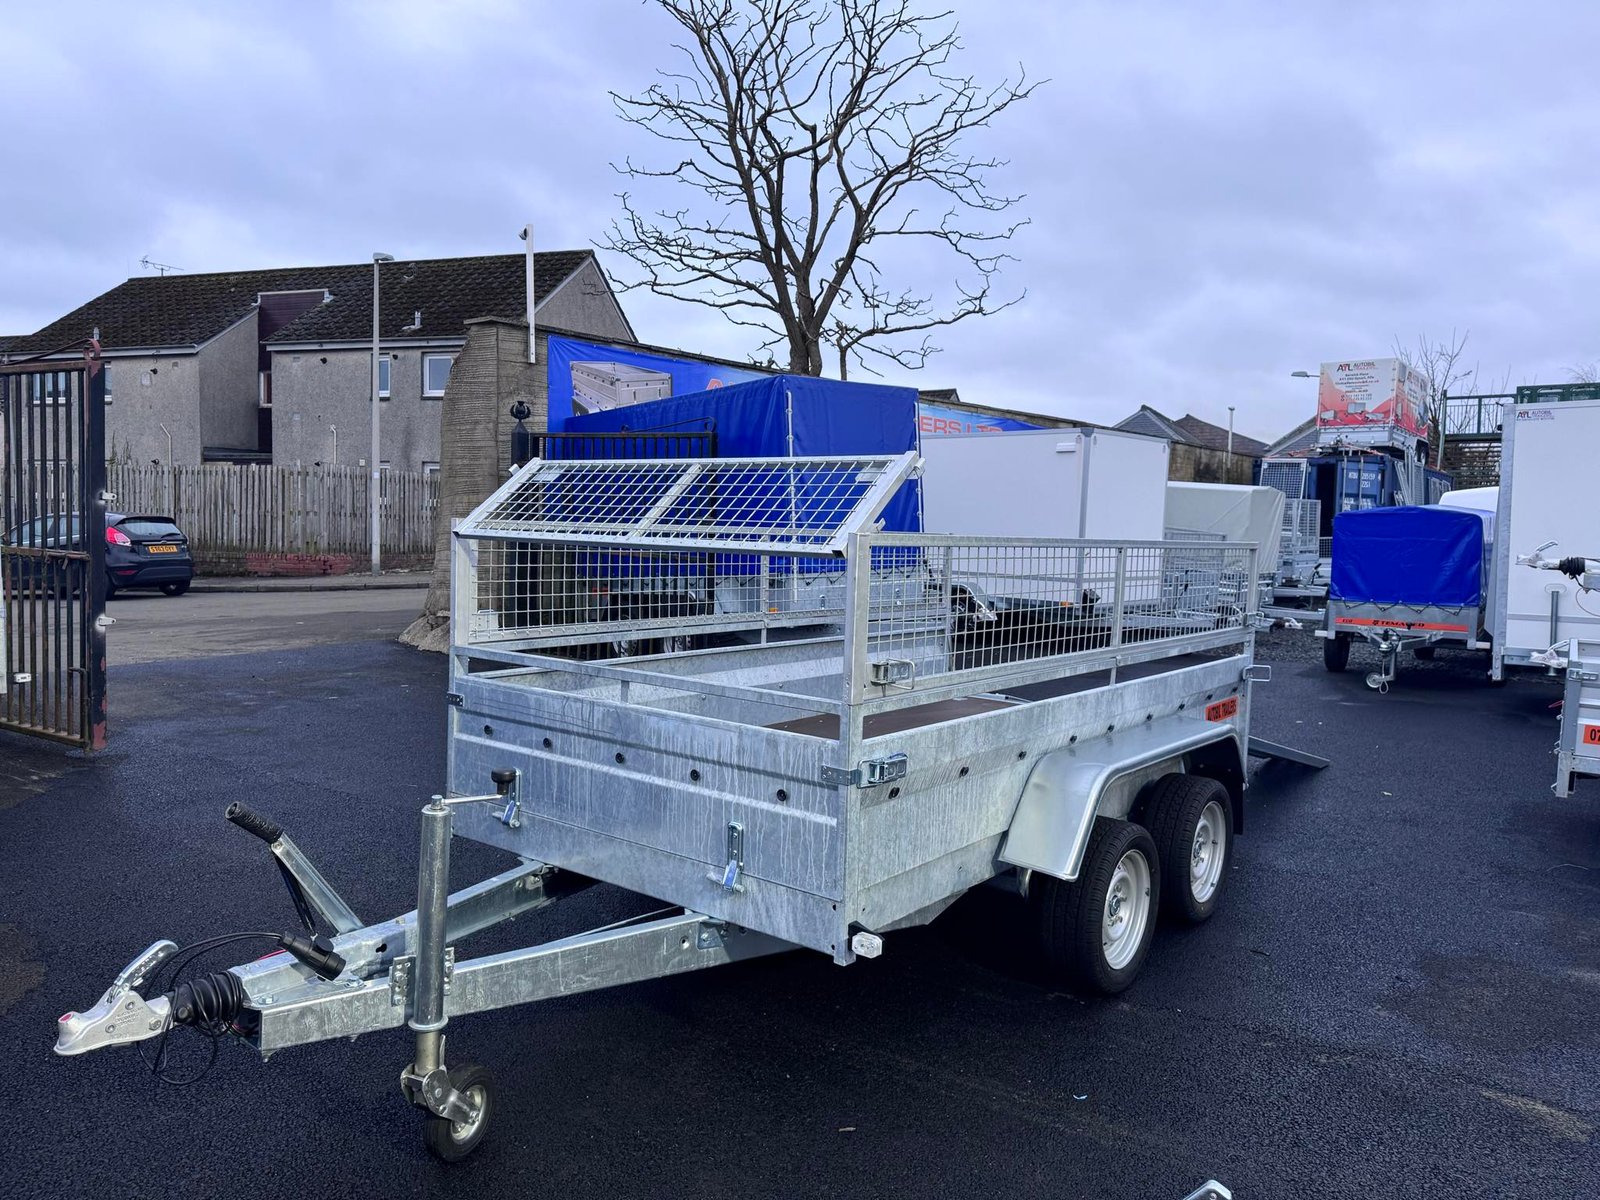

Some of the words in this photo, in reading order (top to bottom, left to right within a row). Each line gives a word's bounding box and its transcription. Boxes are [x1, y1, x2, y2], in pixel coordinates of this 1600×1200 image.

[1336, 363, 1353, 372] ATL
[1516, 410, 1531, 418] ATL
[1207, 704, 1221, 721] AUTOBIL
[1221, 699, 1237, 717] TRAILERS
